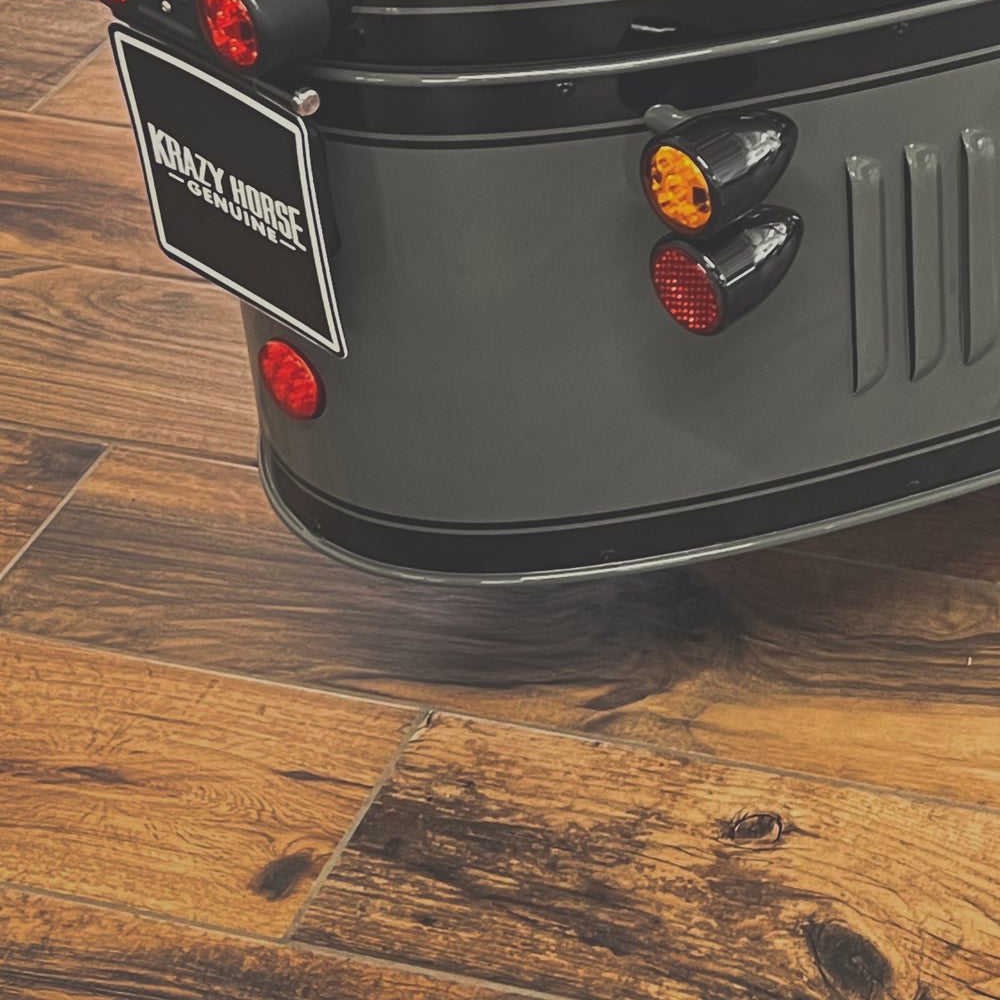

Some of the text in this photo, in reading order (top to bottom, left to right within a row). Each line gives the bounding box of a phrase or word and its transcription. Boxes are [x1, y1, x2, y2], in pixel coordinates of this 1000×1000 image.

[147, 122, 307, 252] KRAZY HORSE
[187, 180, 278, 244] GENUINE
